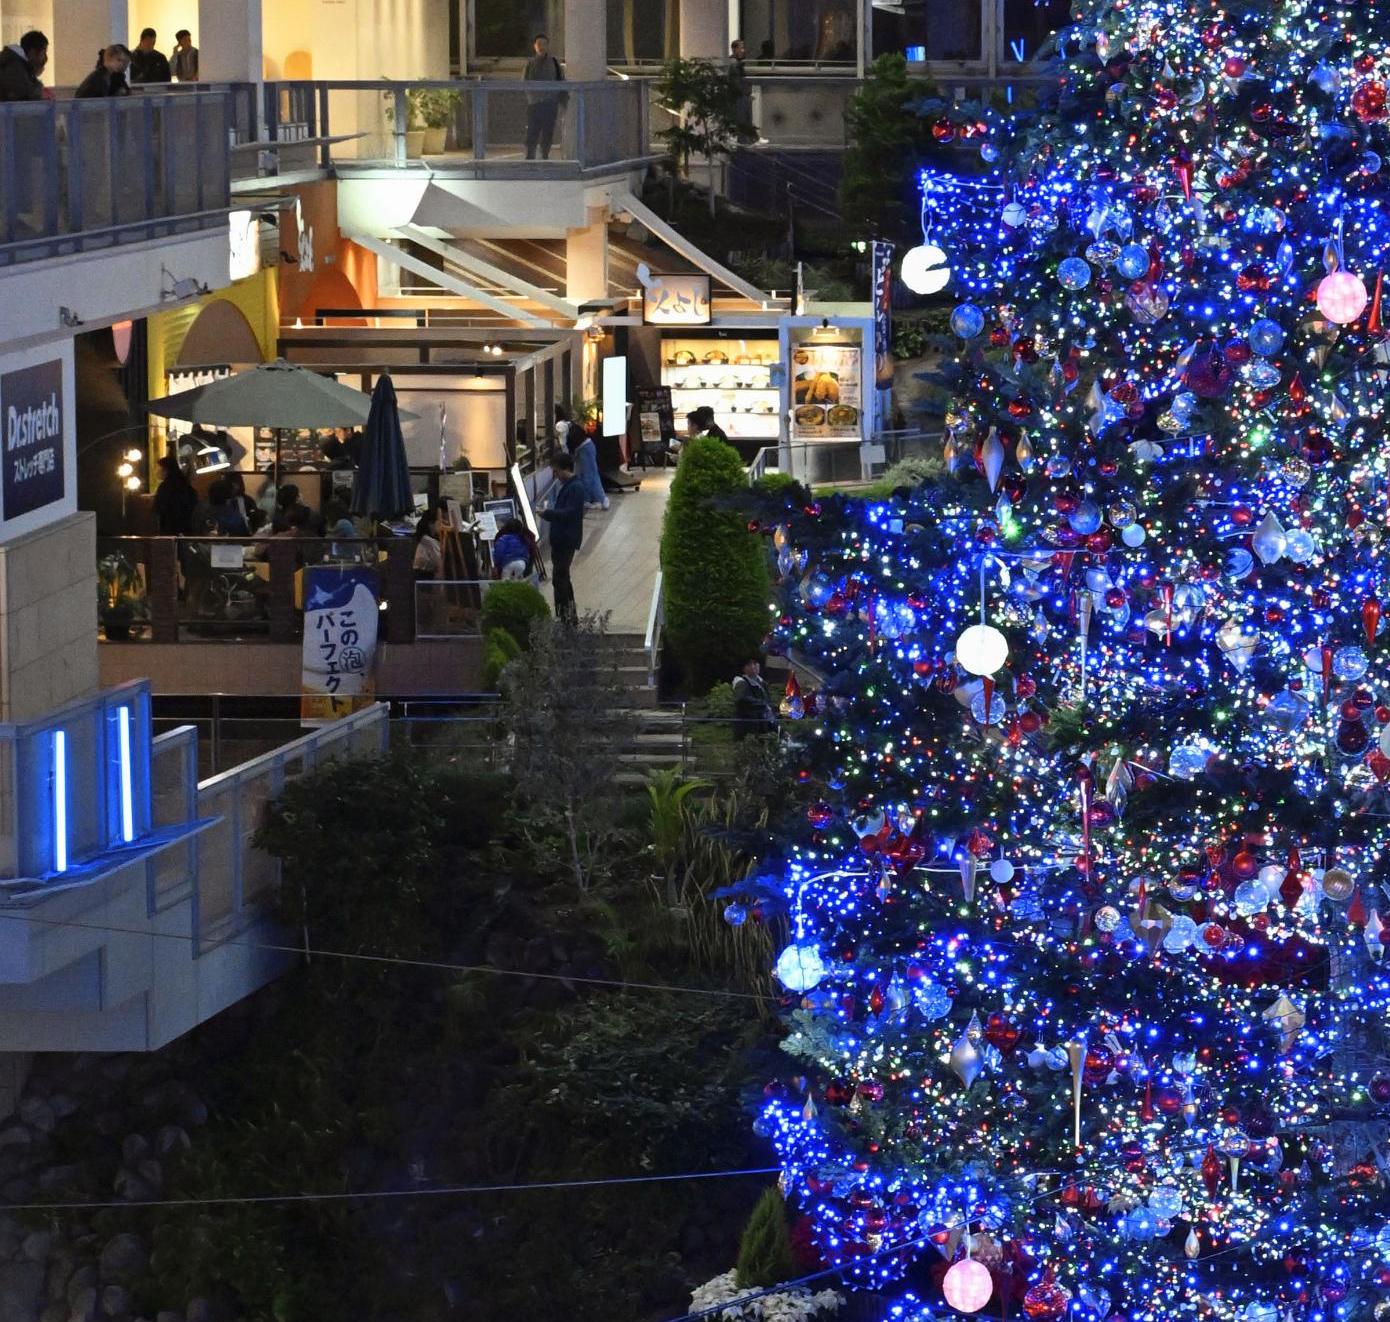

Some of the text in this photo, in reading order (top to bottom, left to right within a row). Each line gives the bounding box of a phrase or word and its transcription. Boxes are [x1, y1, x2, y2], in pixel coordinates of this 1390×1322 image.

[316, 611, 343, 712] パーフェクト
